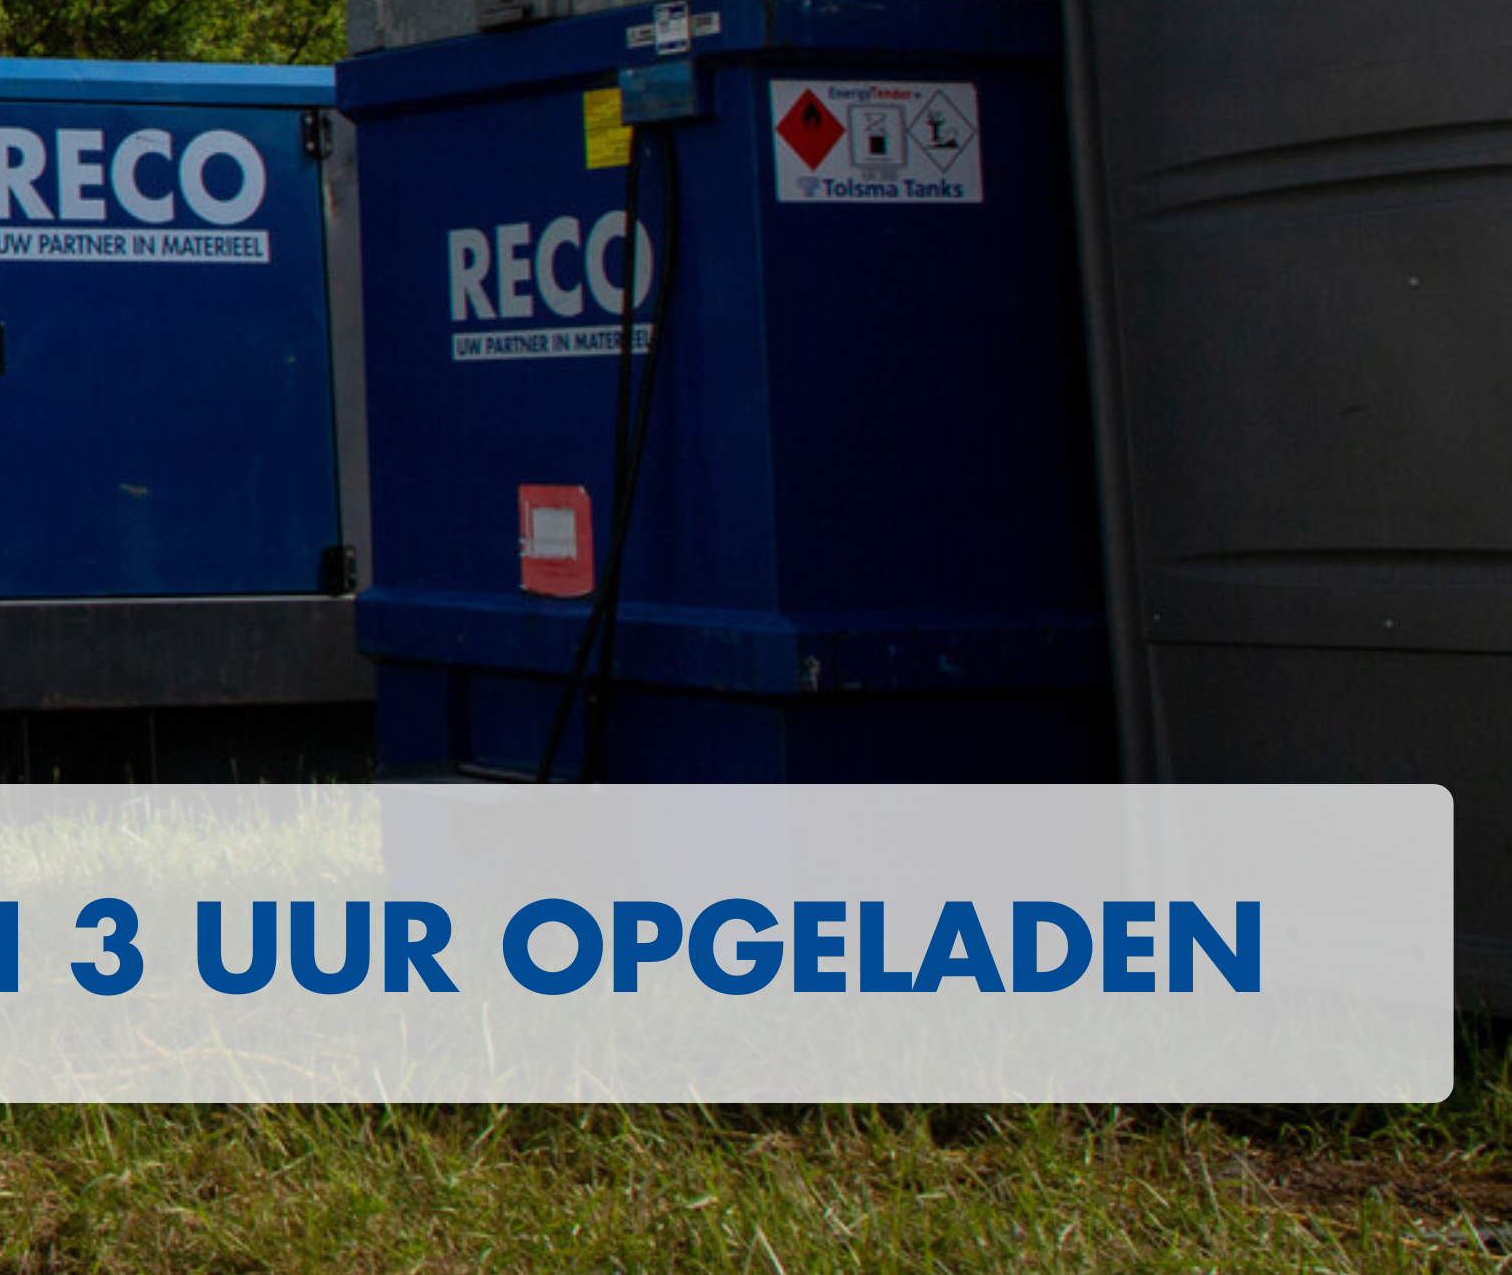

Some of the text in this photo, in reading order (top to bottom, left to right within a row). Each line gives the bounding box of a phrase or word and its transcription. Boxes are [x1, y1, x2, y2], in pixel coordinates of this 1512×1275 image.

[823, 178, 964, 198] Tolsma Tanks
[38, 235, 126, 256] PARTNER
[133, 236, 156, 256] IN
[162, 236, 263, 257] MATERIEEL
[448, 210, 654, 322] RECO
[457, 328, 651, 355] UW PARTNER IN MATEREEL
